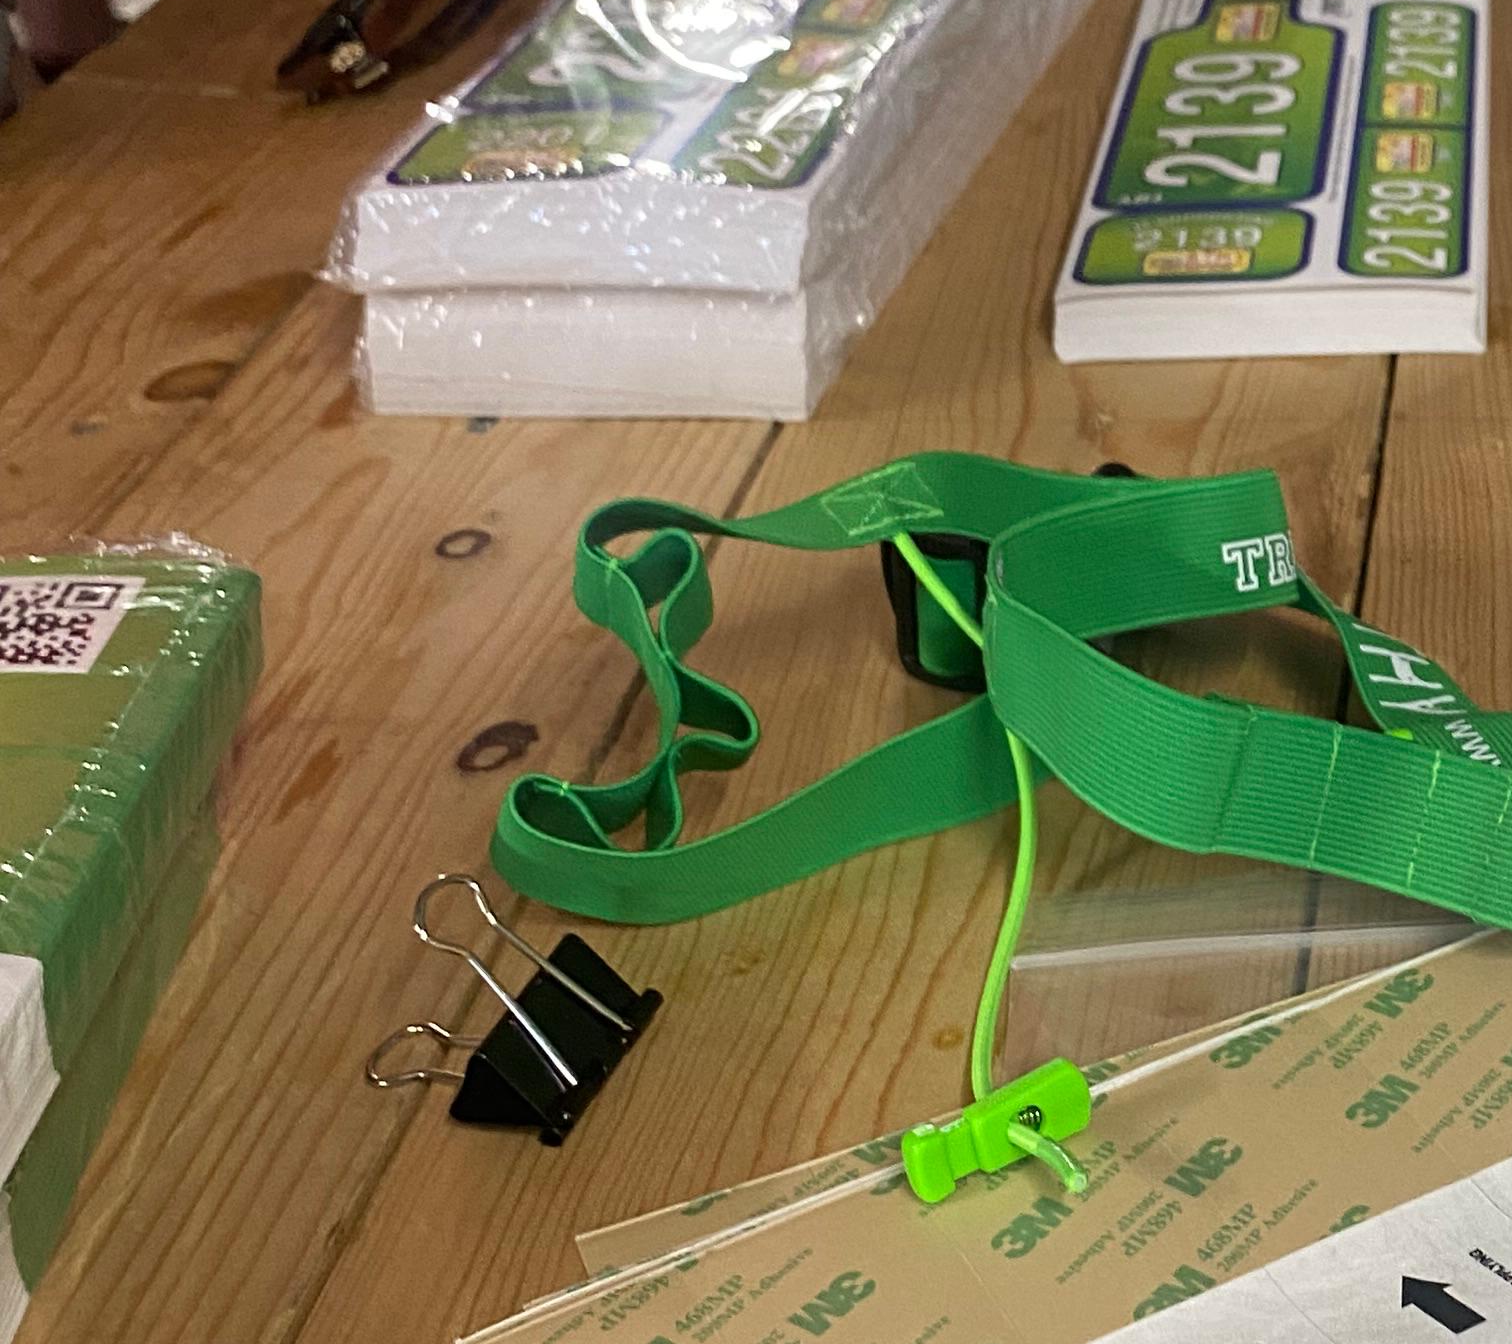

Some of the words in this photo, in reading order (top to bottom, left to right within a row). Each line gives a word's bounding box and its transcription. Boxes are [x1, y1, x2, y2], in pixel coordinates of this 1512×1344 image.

[1387, 6, 1462, 79] 2139
[1144, 52, 1304, 188] 2139
[1364, 181, 1452, 269] 2139
[1363, 967, 1436, 1022] 3M
[1344, 1072, 1420, 1129] 3M
[1165, 1134, 1245, 1199] 3M
[990, 1196, 1073, 1260] 3M
[1195, 1202, 1259, 1262] 468MP
[788, 1270, 878, 1337] 3M
